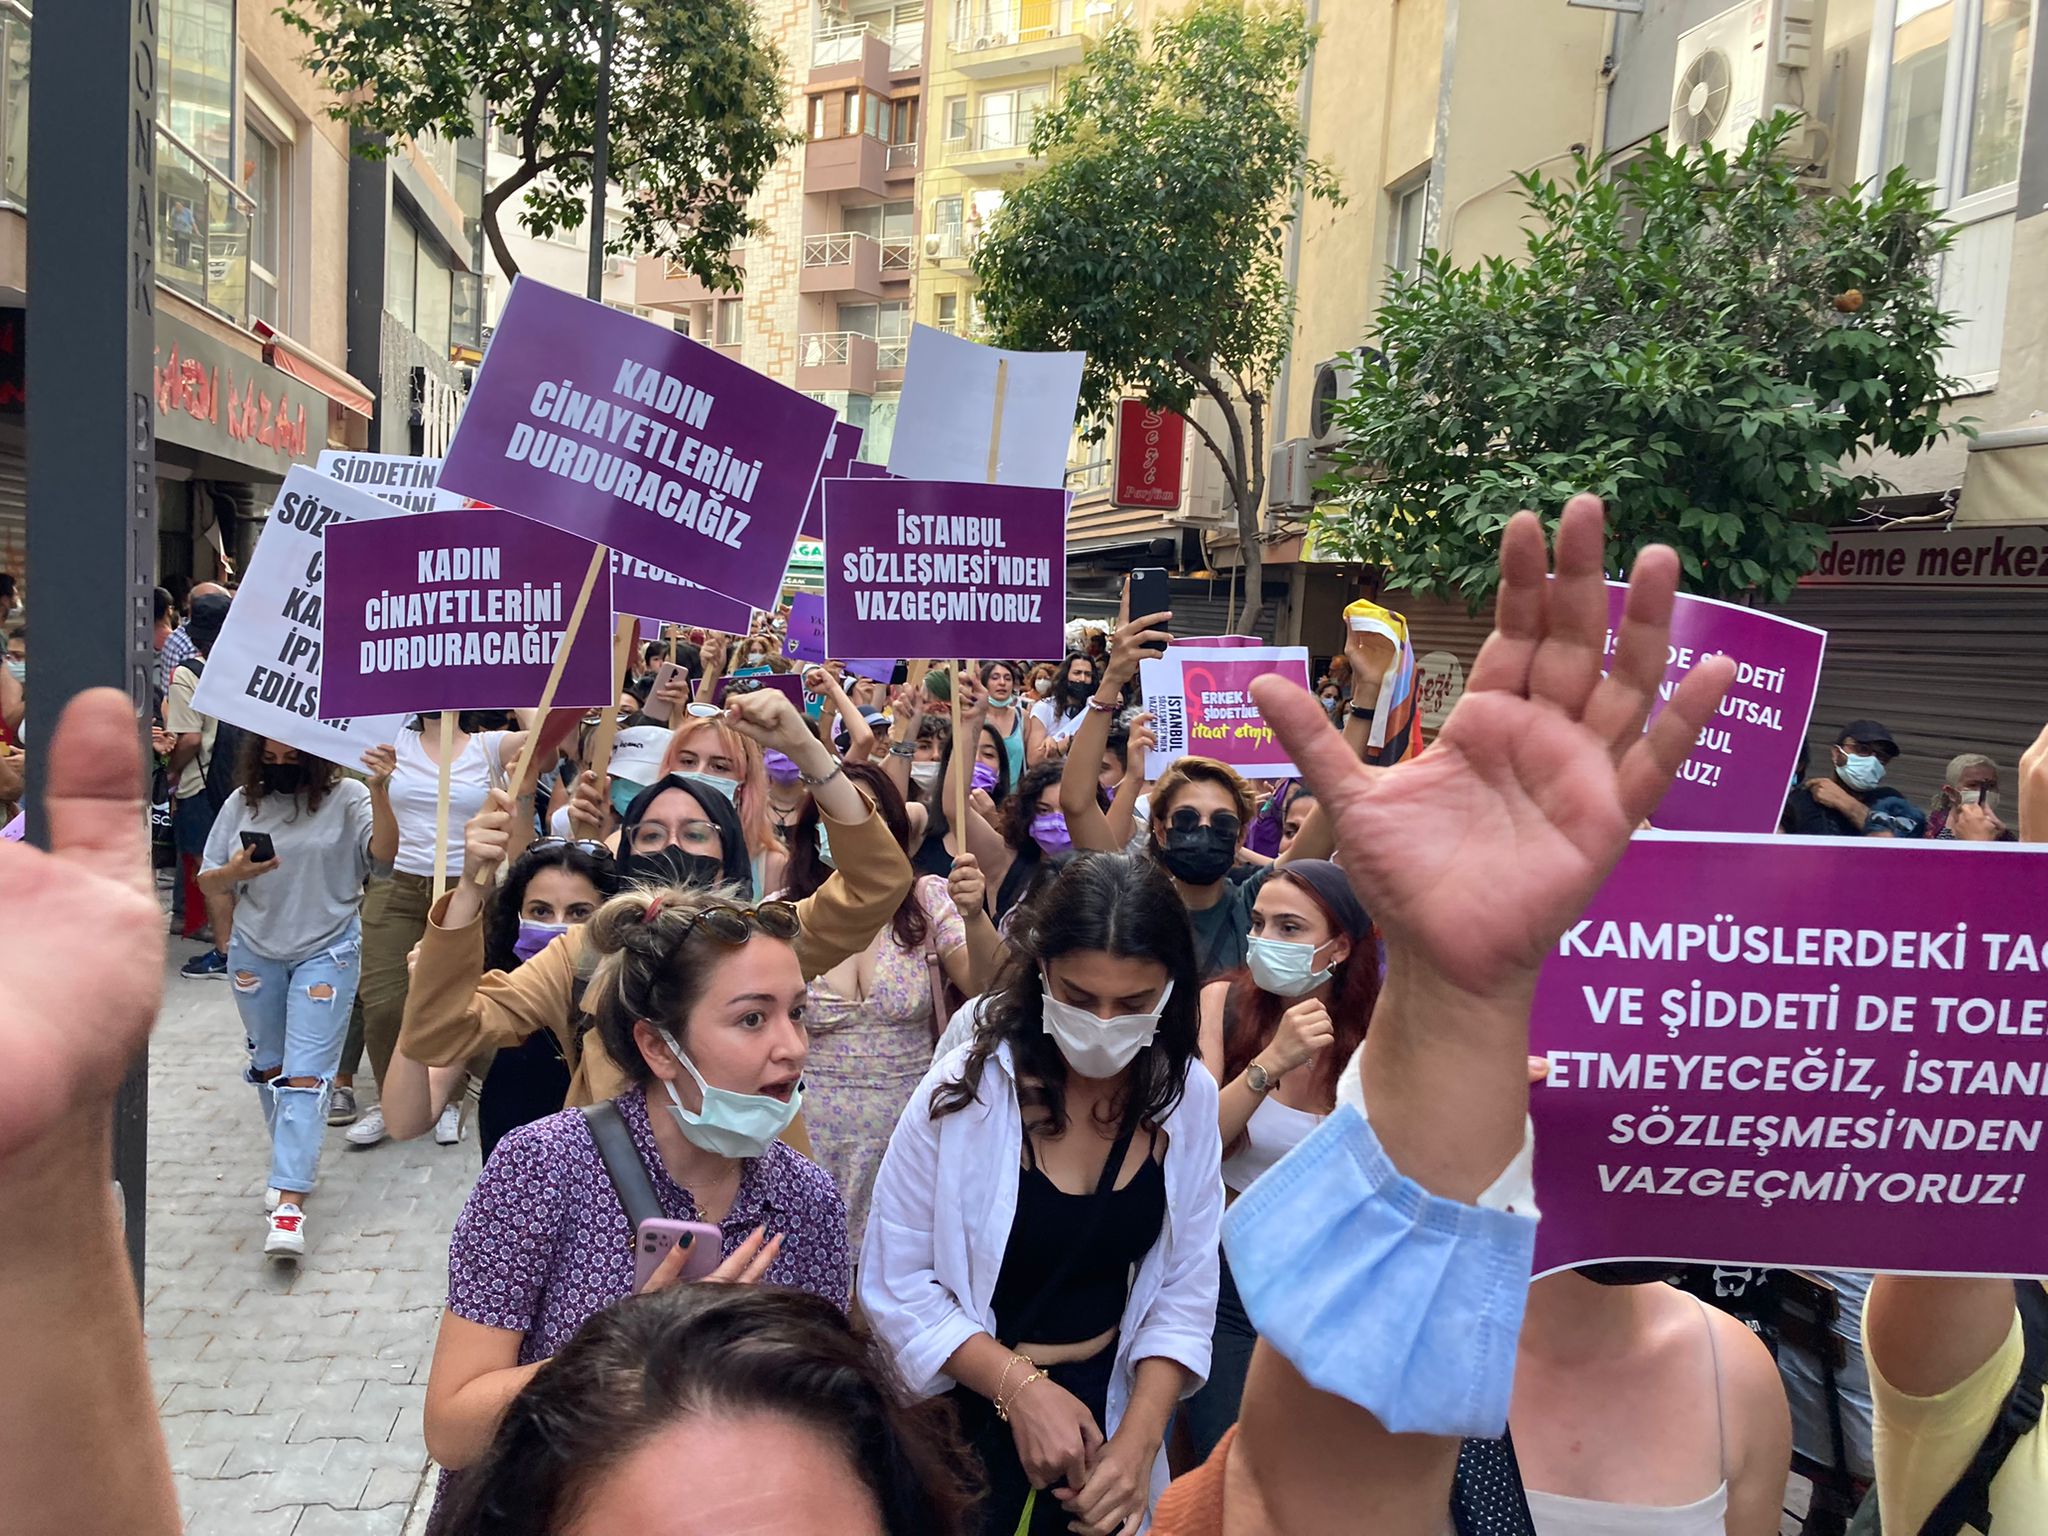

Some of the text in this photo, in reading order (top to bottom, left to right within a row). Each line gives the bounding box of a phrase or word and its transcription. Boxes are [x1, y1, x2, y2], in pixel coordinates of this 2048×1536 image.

[612, 358, 715, 430] KADIN
[529, 379, 763, 503] CİNAYETLERİNİ
[505, 422, 751, 550] DURDURACAĞIZ
[897, 508, 1006, 548] İSTANBUL
[418, 547, 500, 584] KADIN
[843, 546, 1050, 587] SÖZLEŞMESİ'NDEN
[365, 582, 561, 632] CİNAYETLERİNİ
[854, 586, 1042, 624] VAZGEÇMİYORUZ
[1201, 691, 1243, 704] ERKEK
[1714, 695, 1783, 731] UTSAL
[1168, 696, 1183, 752] İSTANBUL
[1192, 720, 1276, 751] itaat etmiy
[1558, 914, 2048, 973] KAMPÜSLERDEKİ TA
[1582, 979, 2048, 1038] VE ŞİDDETİ DE TOLE
[1545, 1047, 2048, 1100] ETMEYECEĞİZ, İSTAN
[1608, 1104, 2043, 1156] SÖZLEŞMESİ'NDEN
[1597, 1163, 2026, 1207] VAZGEÇMİYORUZ!
